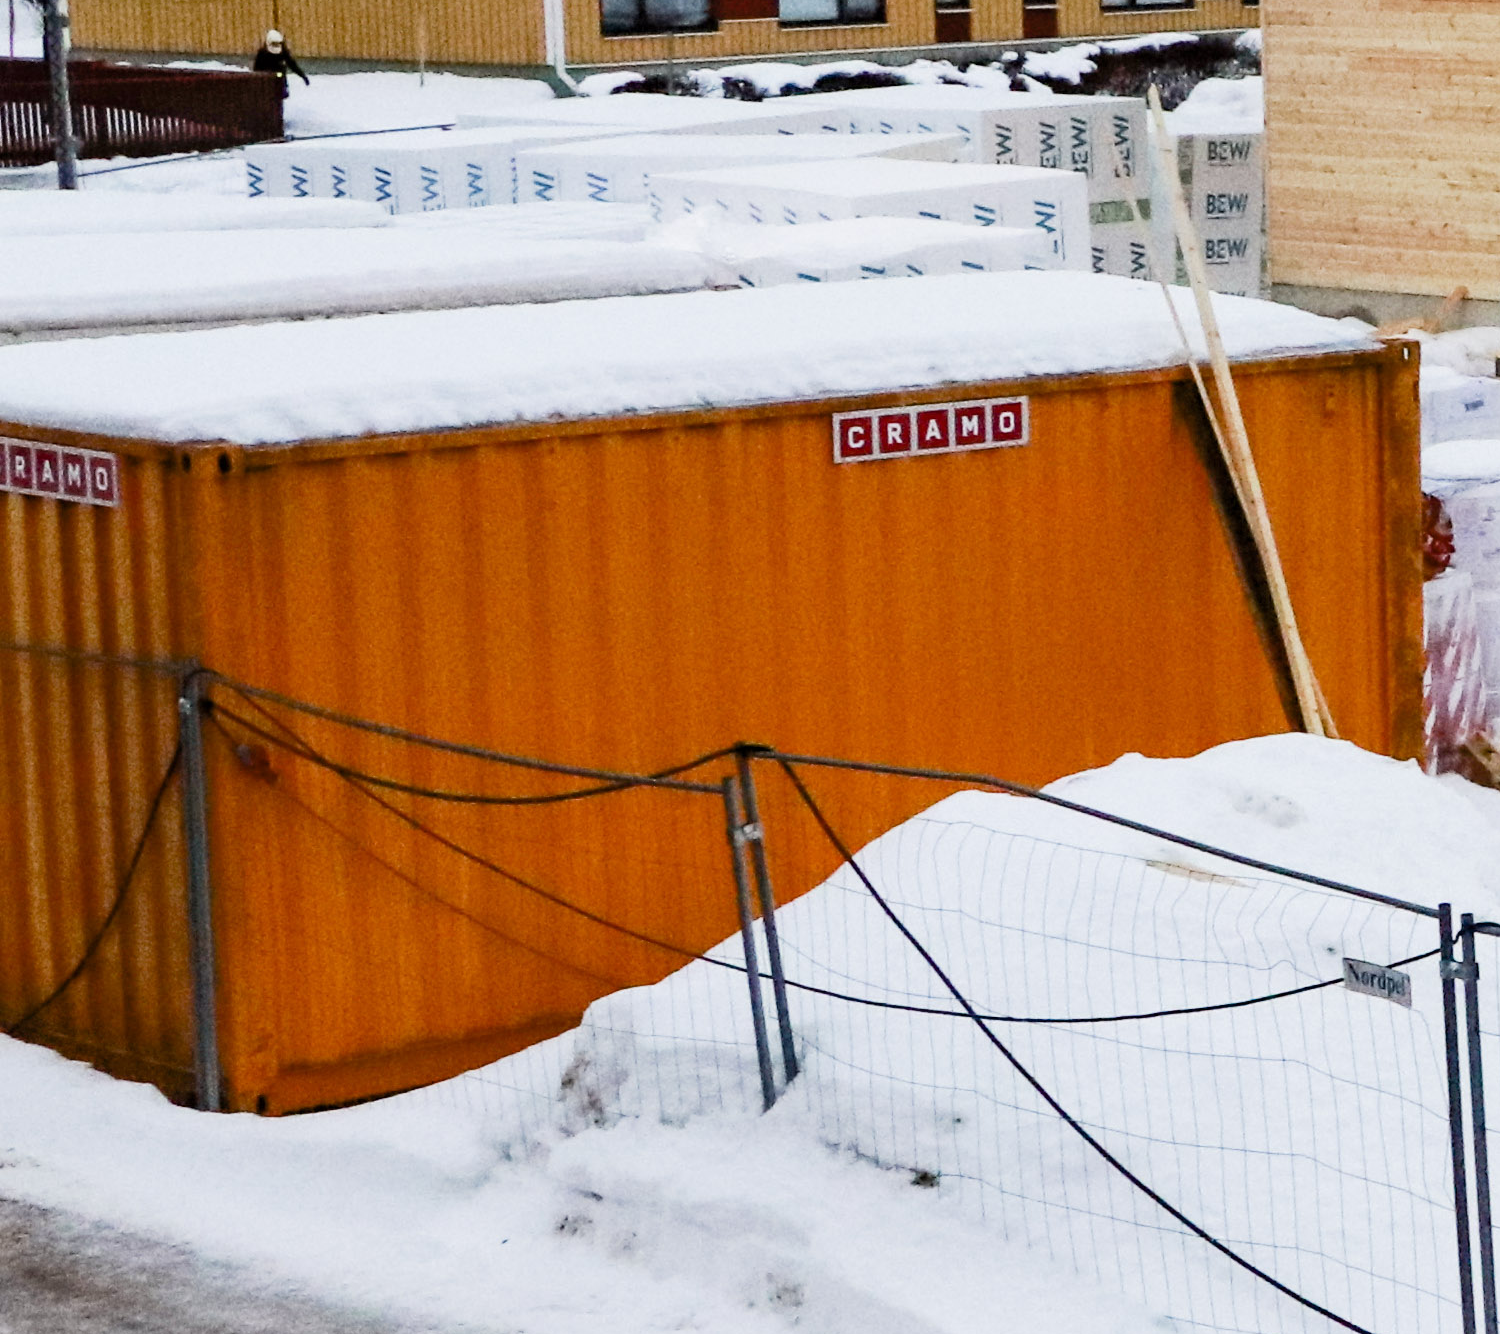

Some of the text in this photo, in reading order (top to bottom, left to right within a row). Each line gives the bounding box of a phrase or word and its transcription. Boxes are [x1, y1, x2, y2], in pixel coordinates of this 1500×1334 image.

[1207, 141, 1250, 161] BEWI
[1206, 194, 1249, 214] BEWI
[1205, 238, 1249, 259] BEWI
[847, 411, 1016, 449] CRAMO
[10, 454, 109, 491] RAMO
